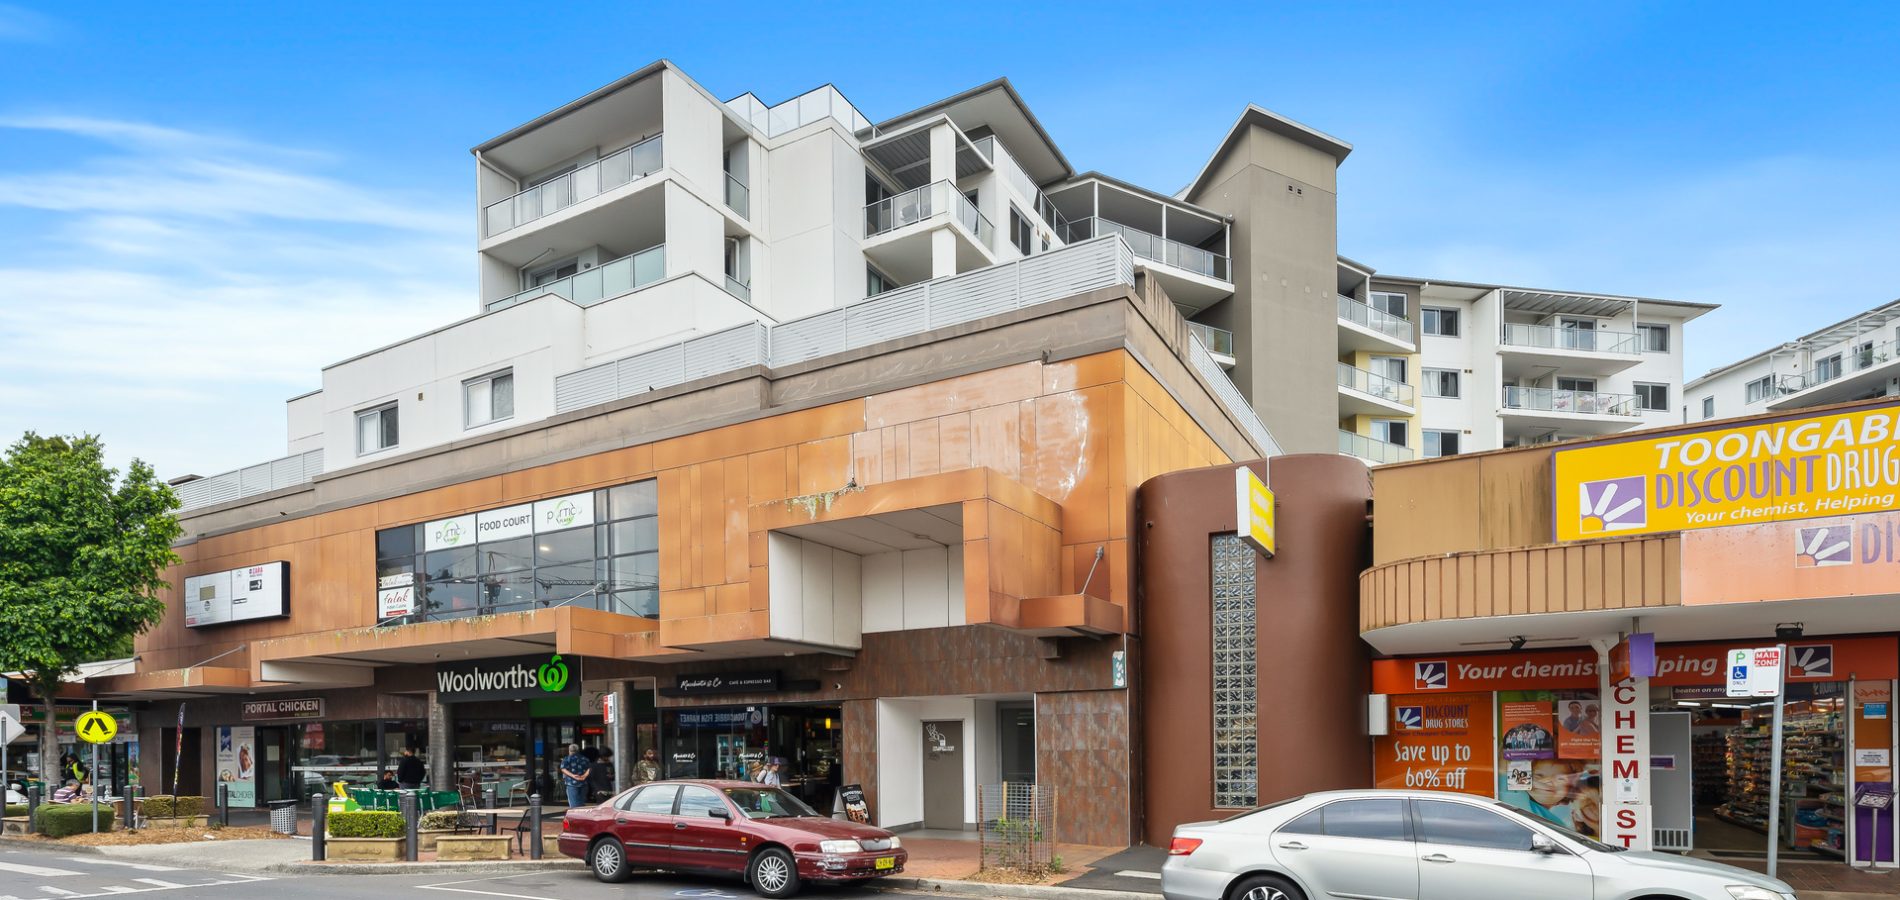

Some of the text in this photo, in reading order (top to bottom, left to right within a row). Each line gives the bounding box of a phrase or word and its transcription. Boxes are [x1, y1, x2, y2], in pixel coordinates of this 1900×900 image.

[1655, 414, 1900, 470] TOONGAB
[1656, 445, 1900, 509] DISCOUNT DRUG
[1686, 494, 1895, 524] Your chemist, Helping
[479, 515, 530, 532] FOOD COURT
[1862, 520, 1900, 564] DI
[1755, 651, 1778, 659] MAIL
[1755, 659, 1778, 667] ZONE
[437, 664, 537, 693] Woolworths
[1456, 663, 1504, 681] Your
[245, 700, 319, 713] PORTAL CHICKEN
[1425, 703, 1470, 718] DISCOUNT
[1425, 717, 1469, 728] DRUG STORES
[1394, 741, 1471, 765] Save up to
[1405, 767, 1467, 789] 60% off
[1613, 686, 1638, 848] CHEMST
